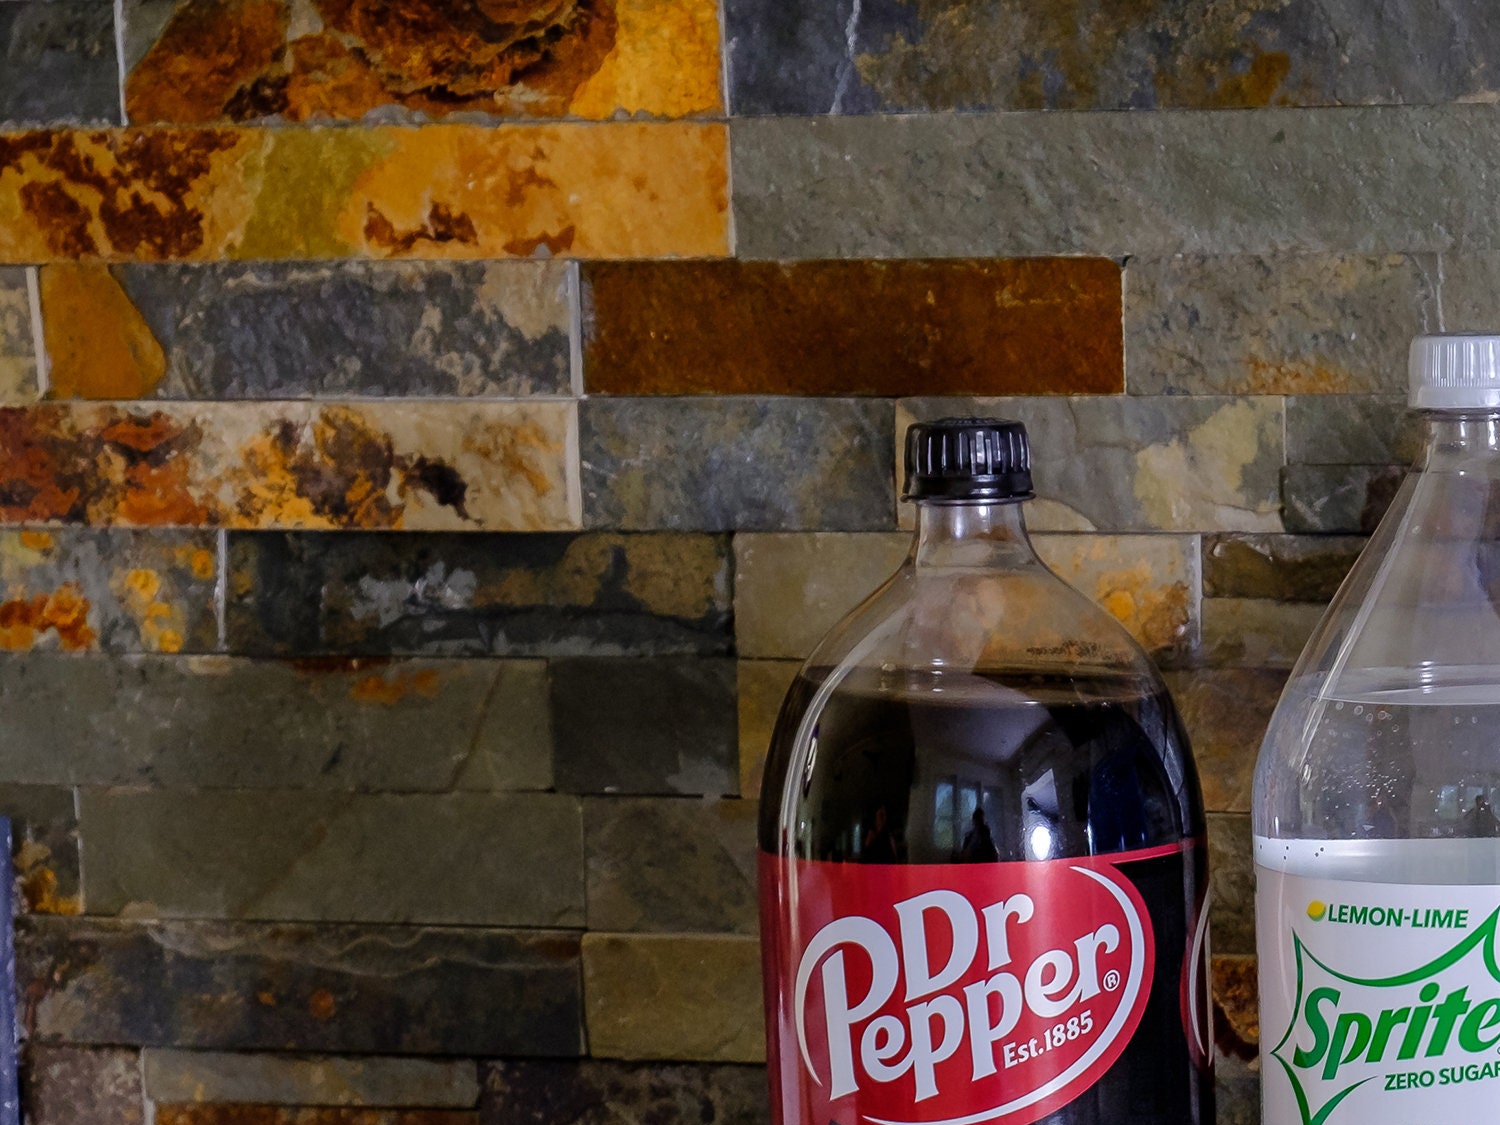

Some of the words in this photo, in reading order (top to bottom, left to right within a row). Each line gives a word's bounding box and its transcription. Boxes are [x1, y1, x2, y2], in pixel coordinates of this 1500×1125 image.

[893, 889, 1034, 1001] Dr
[1328, 903, 1469, 929] LEMON-LIME
[795, 915, 1120, 1102] Pepper
[1384, 1070, 1435, 1092] ZERO
